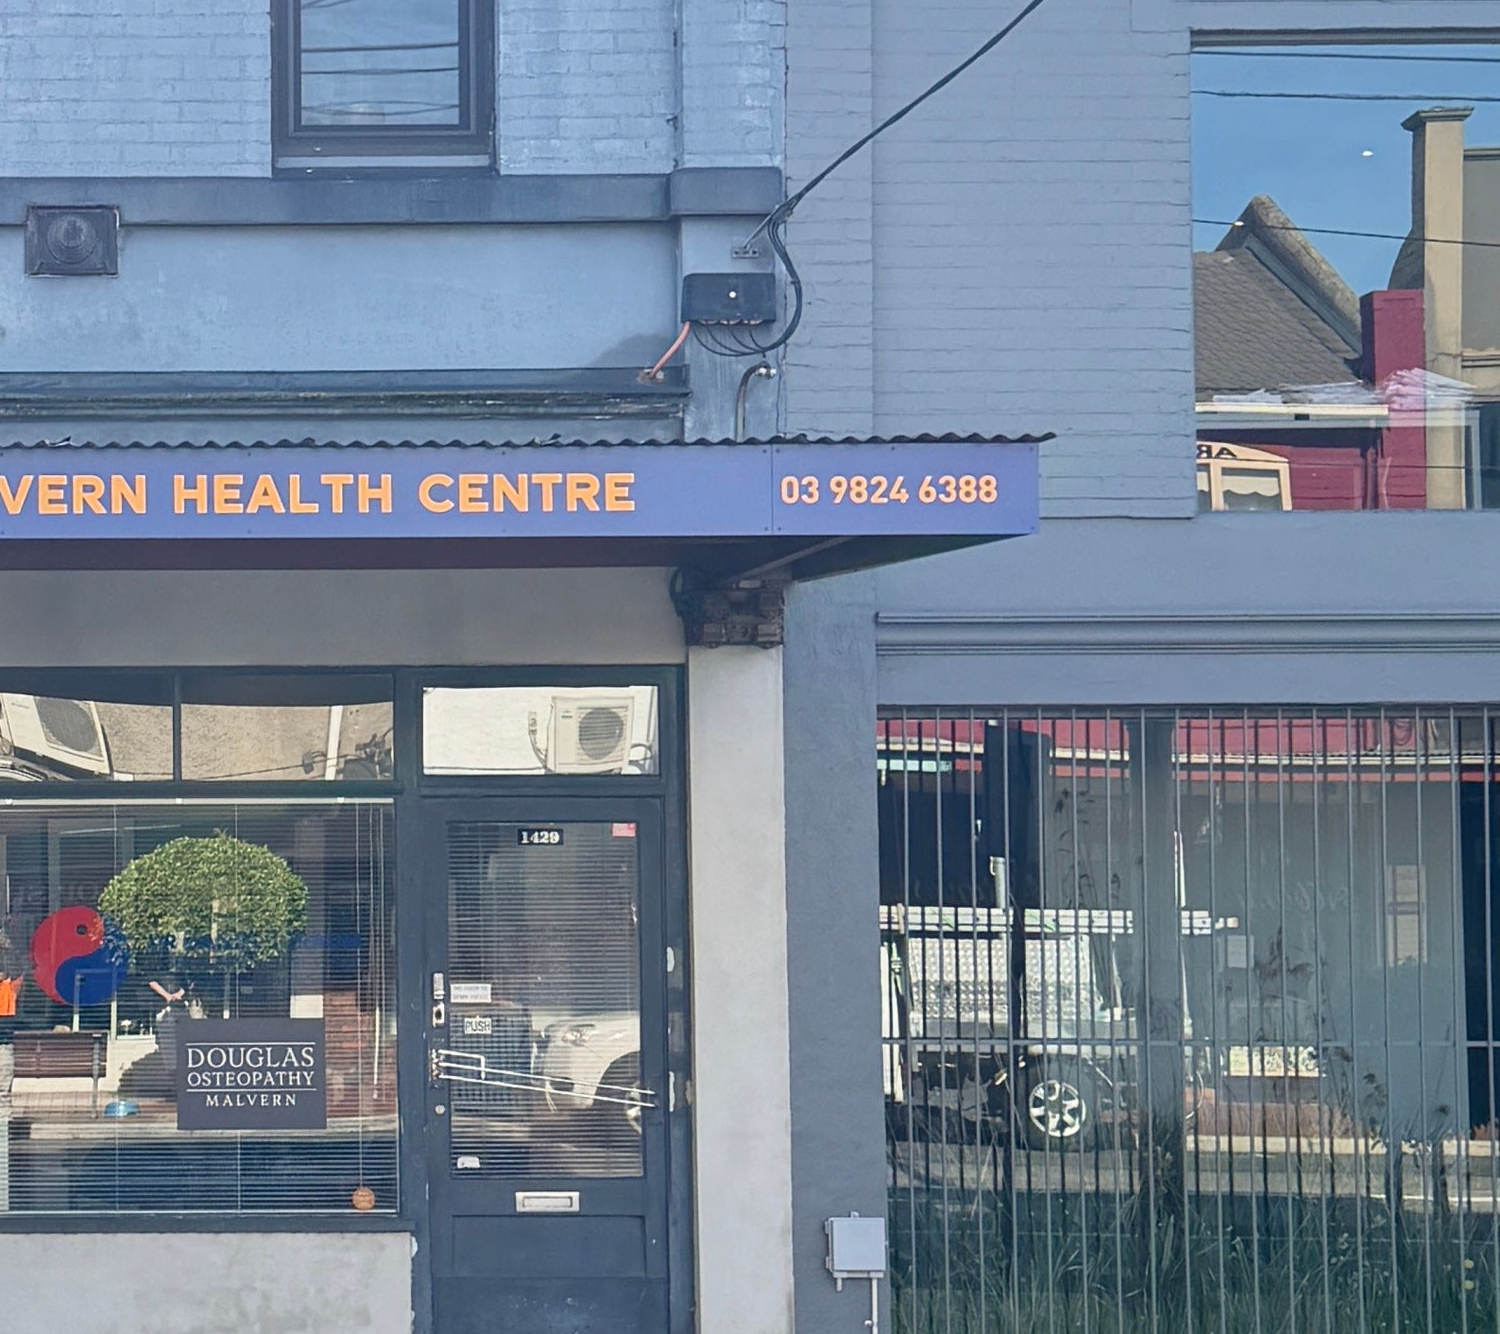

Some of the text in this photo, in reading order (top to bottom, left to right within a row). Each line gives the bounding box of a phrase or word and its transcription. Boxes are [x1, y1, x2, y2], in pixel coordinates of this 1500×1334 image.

[173, 473, 393, 515] HEALTH
[418, 472, 635, 514] CENTRE
[780, 474, 999, 505] 03 9824 6388
[187, 1046, 315, 1069] DOUGLAS
[186, 1070, 315, 1087] OSTEOPATHY
[205, 1093, 297, 1108] MALVERN
